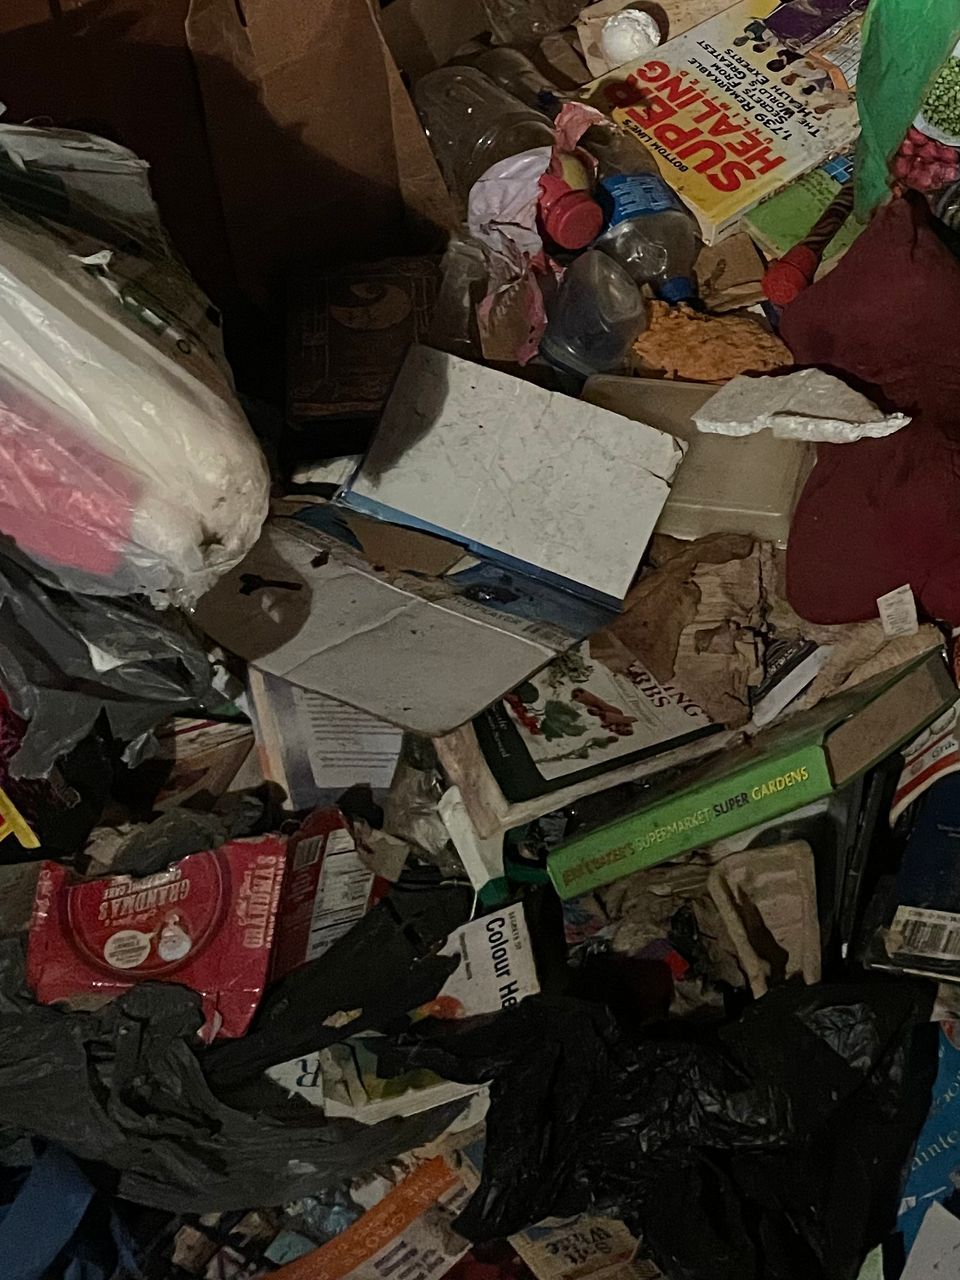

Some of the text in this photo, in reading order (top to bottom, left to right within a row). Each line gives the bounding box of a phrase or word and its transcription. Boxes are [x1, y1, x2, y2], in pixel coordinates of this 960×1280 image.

[636, 59, 785, 177] HEALING
[687, 55, 793, 141] 1,739 REMARKABLE
[696, 37, 822, 138] THE WORLD'S GREATEST
[709, 60, 787, 125] SECRETS FROM
[723, 46, 811, 118] HEALTH EXPERTS
[602, 73, 754, 193] SUPER
[621, 117, 689, 173] BOTTOM LINE'S
[634, 806, 714, 852] SUPERMARKET
[711, 790, 750, 817] SUPER
[749, 765, 810, 802] GARDENS
[97, 877, 191, 921] GRANDMA'S
[242, 853, 277, 947] GRANDMA'S
[484, 915, 515, 979] Colour
